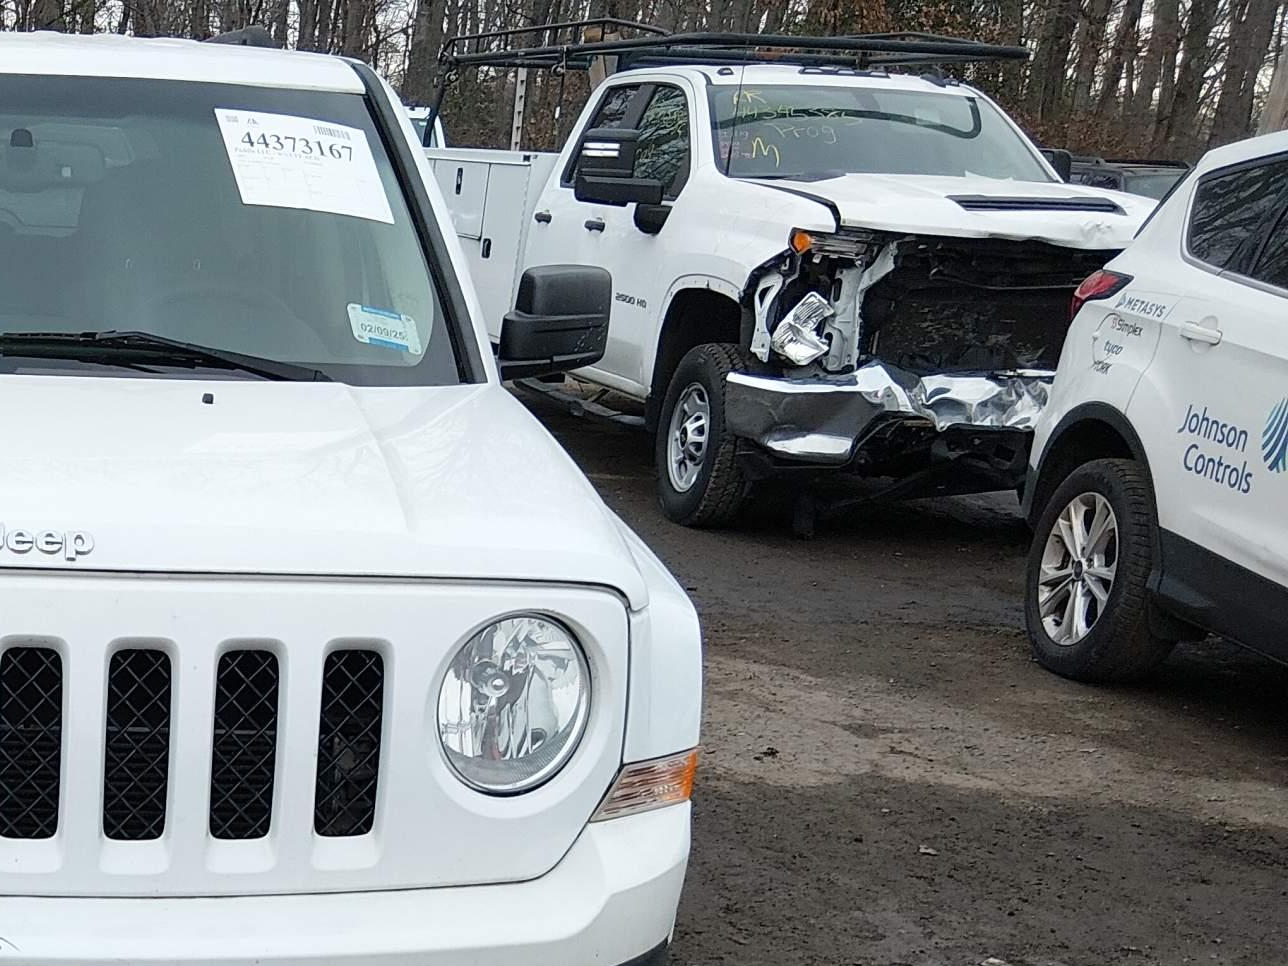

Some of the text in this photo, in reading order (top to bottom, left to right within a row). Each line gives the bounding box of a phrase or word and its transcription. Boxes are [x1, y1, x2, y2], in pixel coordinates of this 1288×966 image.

[241, 131, 353, 162] 44373167
[1124, 297, 1166, 318] METASYS
[1103, 340, 1124, 356] tyco
[1177, 404, 1249, 453] Johnson
[1183, 443, 1253, 494] Controls
